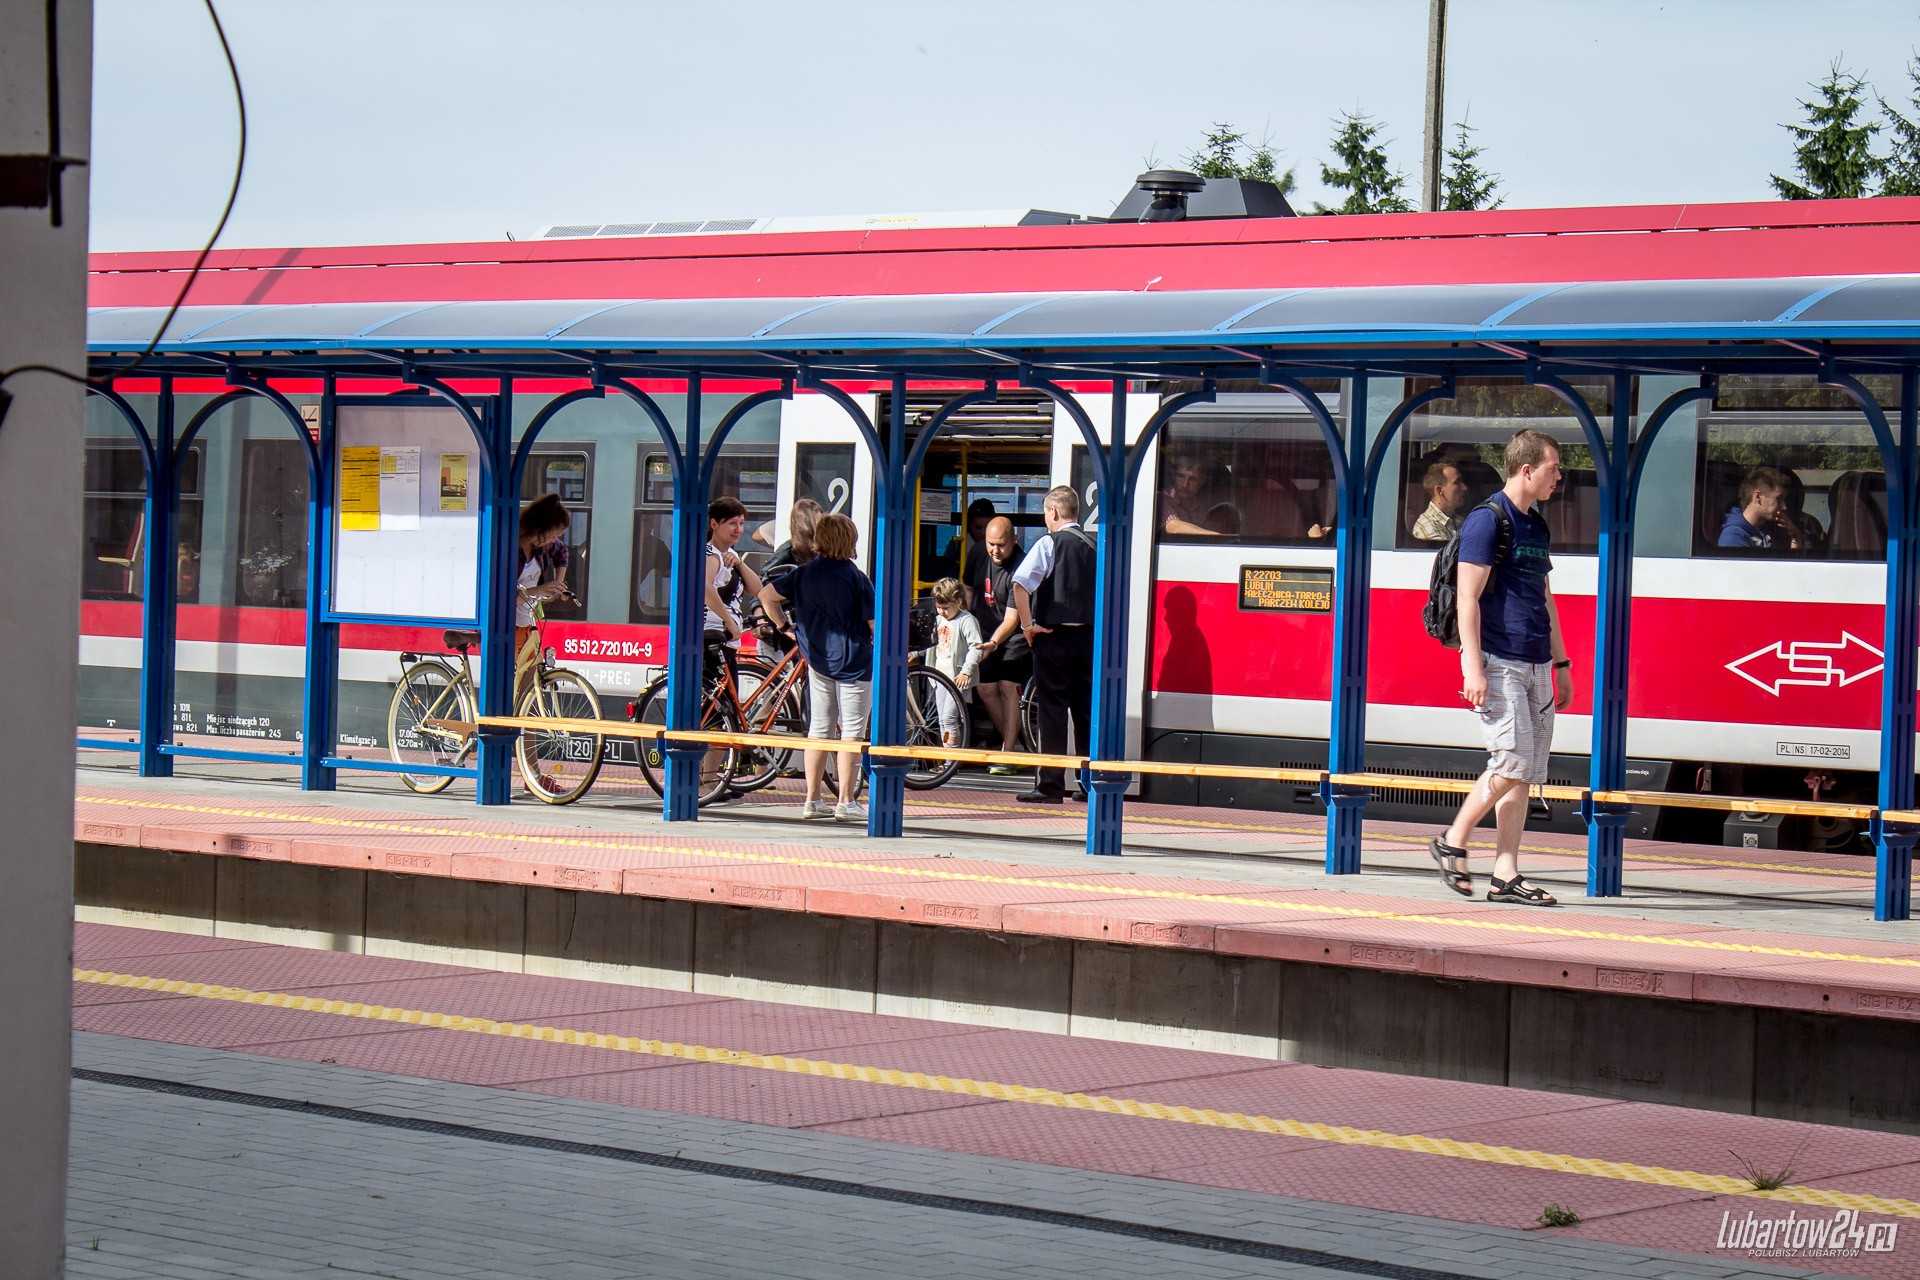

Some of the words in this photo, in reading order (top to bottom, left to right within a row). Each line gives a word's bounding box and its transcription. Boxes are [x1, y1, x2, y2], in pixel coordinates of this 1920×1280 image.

[827, 477, 850, 514] 2
[1245, 569, 1251, 579] R
[1253, 570, 1282, 580] 22703
[1244, 581, 1274, 591] LUBLIN
[1258, 599, 1297, 608] PARCZEW
[1299, 600, 1331, 610] KOLEJO
[564, 638, 578, 654] 95
[600, 640, 620, 656] 720
[622, 641, 653, 657] 104-9
[206, 713, 226, 725] Miejsc
[259, 717, 270, 727] 120
[220, 726, 236, 736] liczba
[236, 727, 266, 738] pasażerów
[268, 728, 282, 739] 245
[339, 733, 377, 747] Klimatyzacja
[568, 739, 590, 757] 120
[1780, 744, 1790, 753] PL
[1795, 745, 1805, 754] NS
[1810, 746, 1849, 756] 17-02-2014
